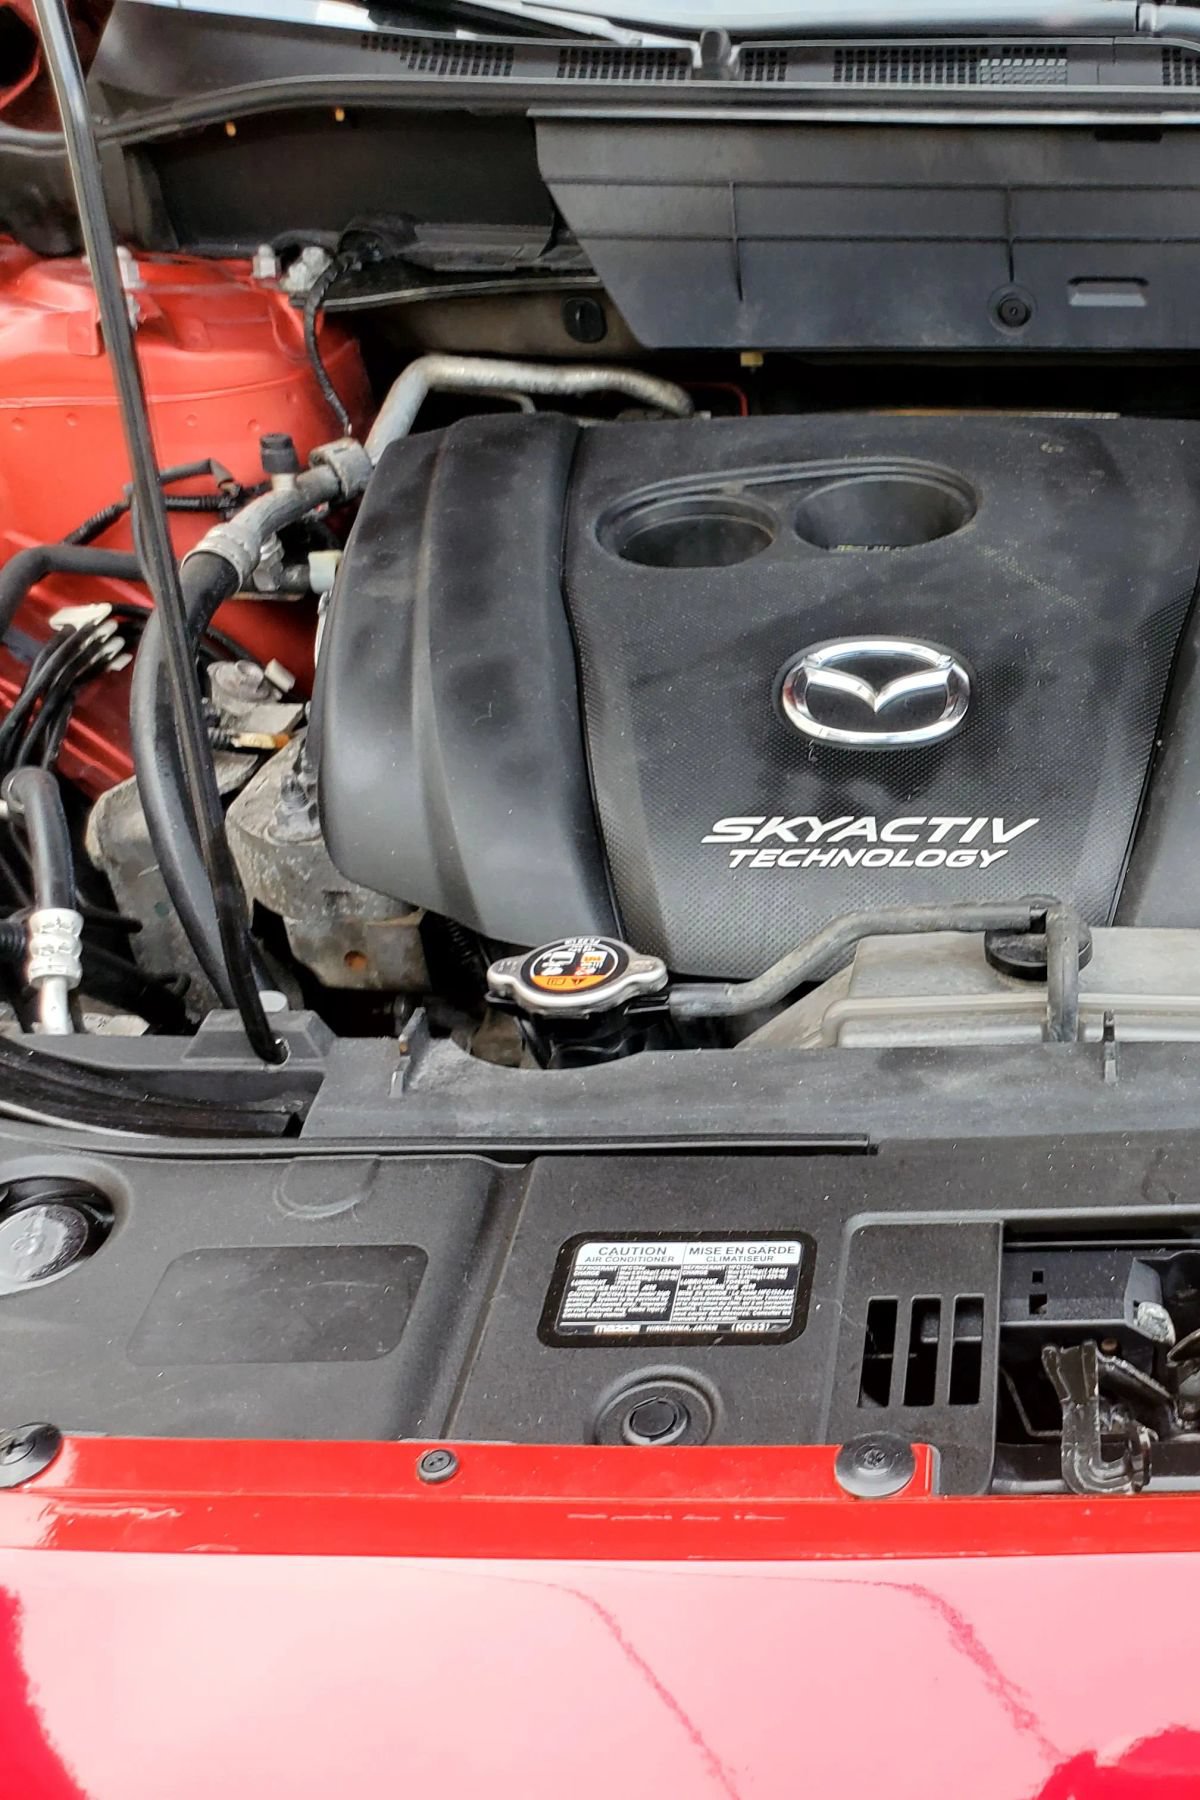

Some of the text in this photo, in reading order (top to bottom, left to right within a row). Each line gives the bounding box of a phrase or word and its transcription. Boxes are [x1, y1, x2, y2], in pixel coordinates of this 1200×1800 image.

[700, 815, 1041, 844] SKYACTIV
[727, 848, 1009, 869] TECHNOLOGY
[598, 1247, 667, 1256] CAUTION
[689, 1245, 796, 1255] MISE EN GARDE
